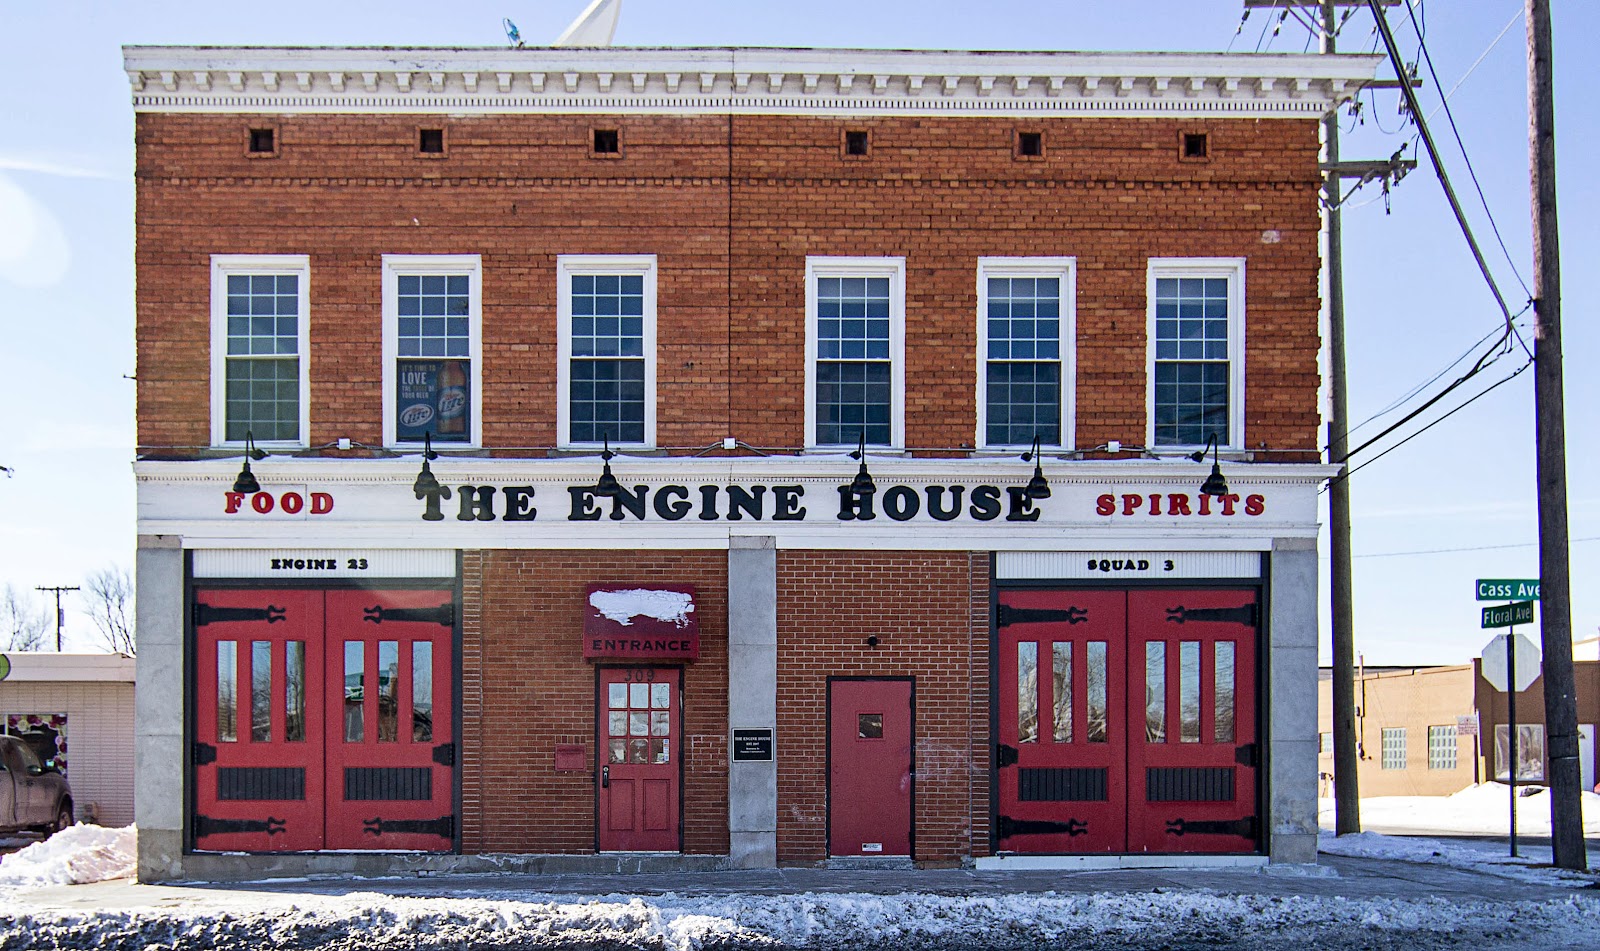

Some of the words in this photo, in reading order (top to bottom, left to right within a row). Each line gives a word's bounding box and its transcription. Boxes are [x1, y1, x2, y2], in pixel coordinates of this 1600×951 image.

[401, 372, 427, 385] LOVE
[224, 491, 334, 514] FOOD
[414, 485, 537, 521] THE
[567, 484, 807, 521] ENGINE
[836, 484, 1041, 521] HOUSE
[1096, 493, 1265, 516] SPIRITS
[271, 559, 337, 570] ENGINE
[347, 559, 368, 570] 23
[1087, 559, 1150, 572] SQUAD
[1163, 559, 1175, 571] 3
[1479, 583, 1512, 597] Cass
[1517, 583, 1541, 597] Ave
[1484, 608, 1513, 625] Floral
[1516, 607, 1531, 620] Ave
[592, 639, 691, 651] ENTRANCE
[624, 669, 655, 682] 309
